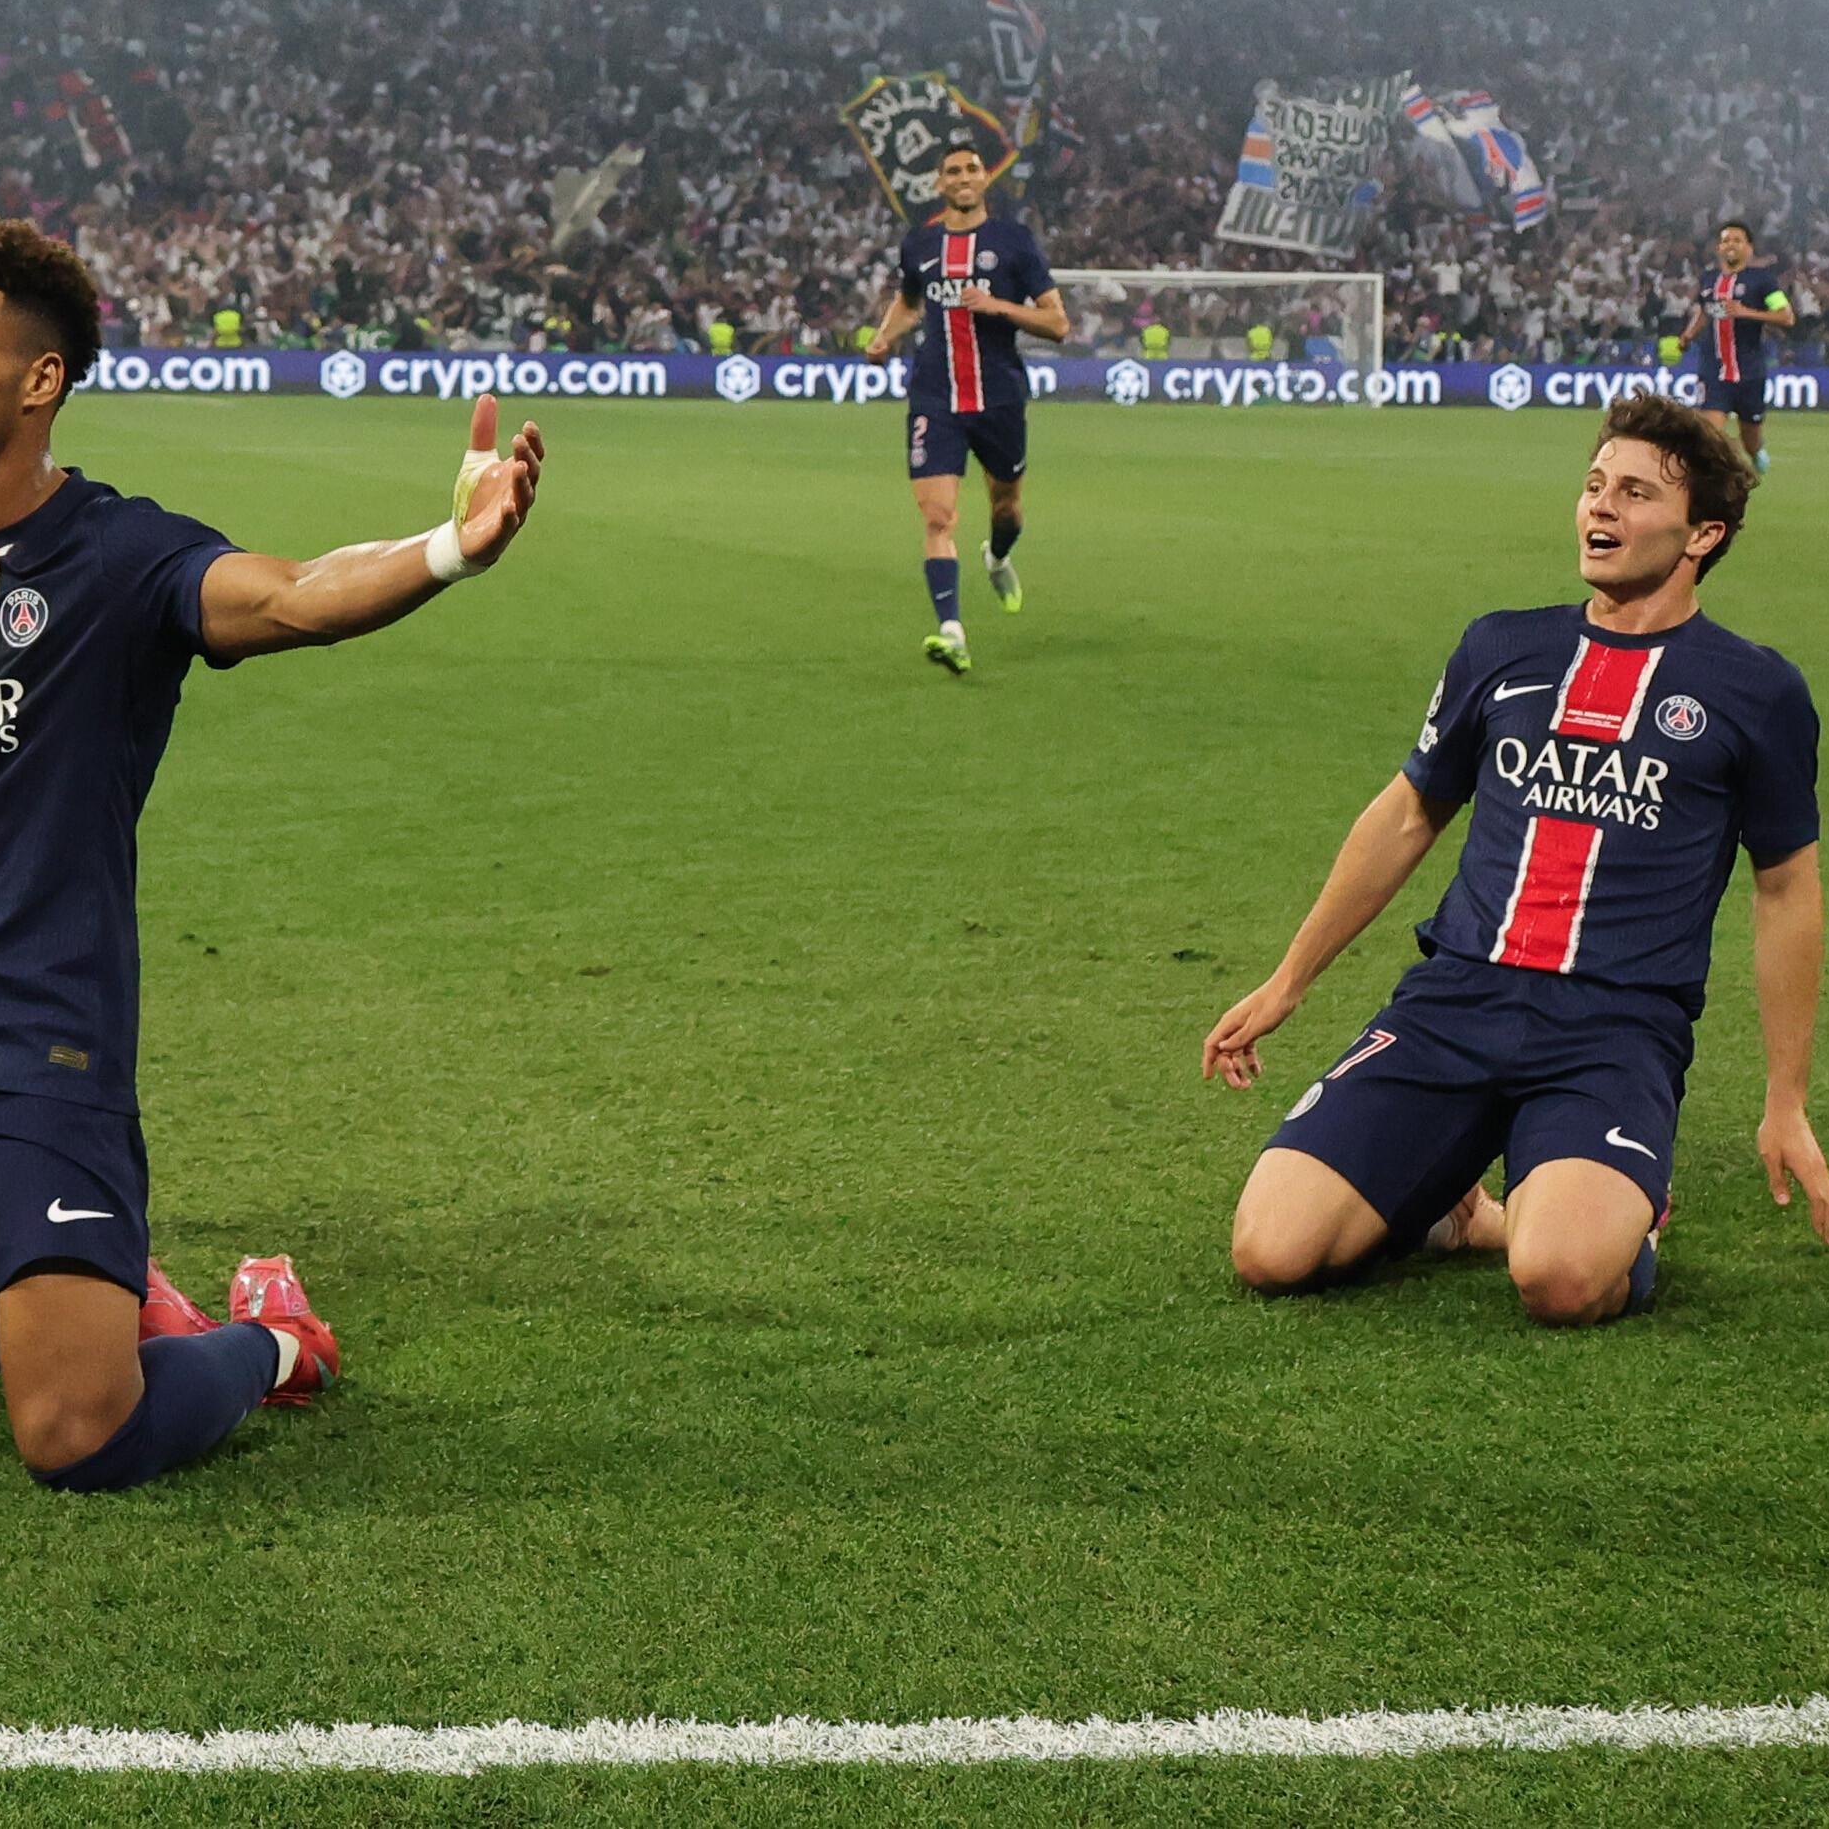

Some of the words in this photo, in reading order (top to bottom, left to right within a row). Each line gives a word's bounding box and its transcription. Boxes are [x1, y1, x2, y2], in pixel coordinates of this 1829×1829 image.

[379, 353, 667, 401] crypto.com
[1163, 362, 1442, 407] crypto.com
[7, 591, 40, 606] PARIS
[1495, 737, 1669, 803] QATAR
[1522, 782, 1662, 832] AIRWAYS
[1325, 1029, 1397, 1080] 7
